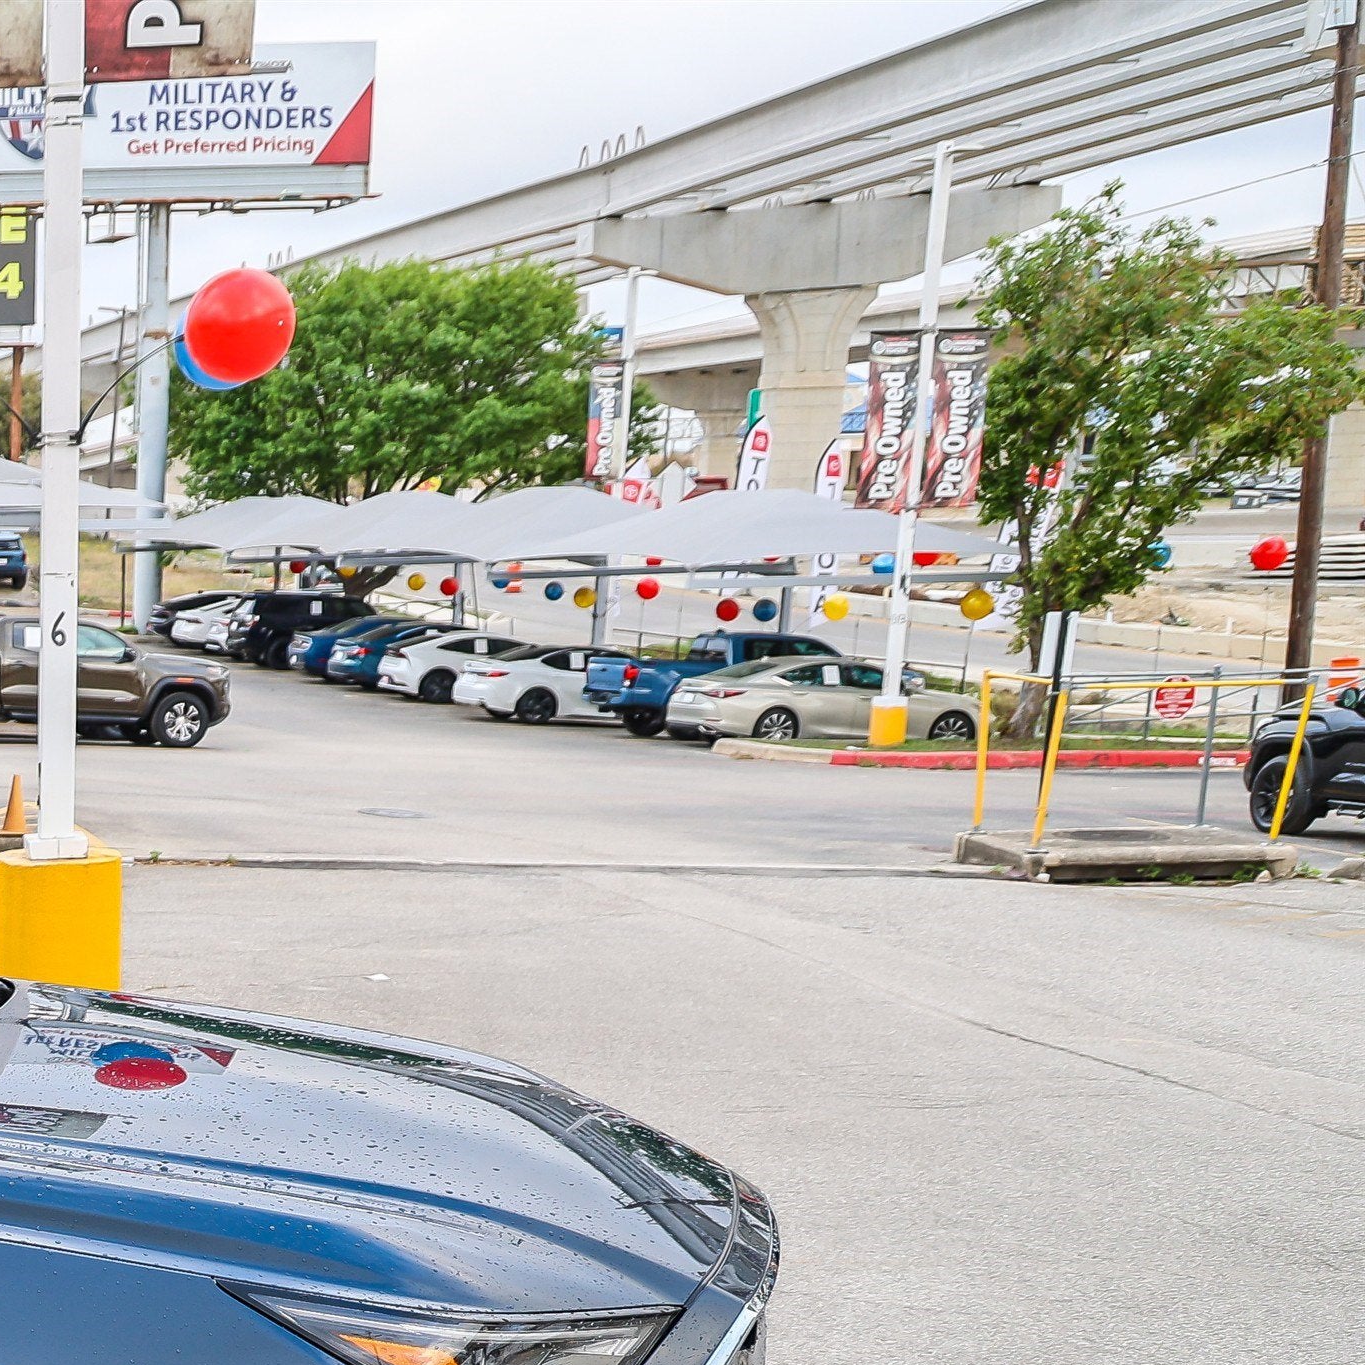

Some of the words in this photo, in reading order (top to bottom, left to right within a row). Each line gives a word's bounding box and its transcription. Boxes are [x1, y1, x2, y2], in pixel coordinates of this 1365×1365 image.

[149, 80, 272, 105] MILITARY
[280, 80, 299, 102] &
[110, 110, 148, 133] 1st
[156, 107, 333, 132] RESPONDERS
[128, 138, 159, 155] Get
[165, 136, 246, 154] Preferred
[253, 135, 314, 155] Pricing
[875, 371, 907, 456] Owned
[941, 370, 973, 455] Owned
[869, 458, 898, 499] Pre
[934, 457, 965, 498] Pre
[50, 611, 67, 647] 6
